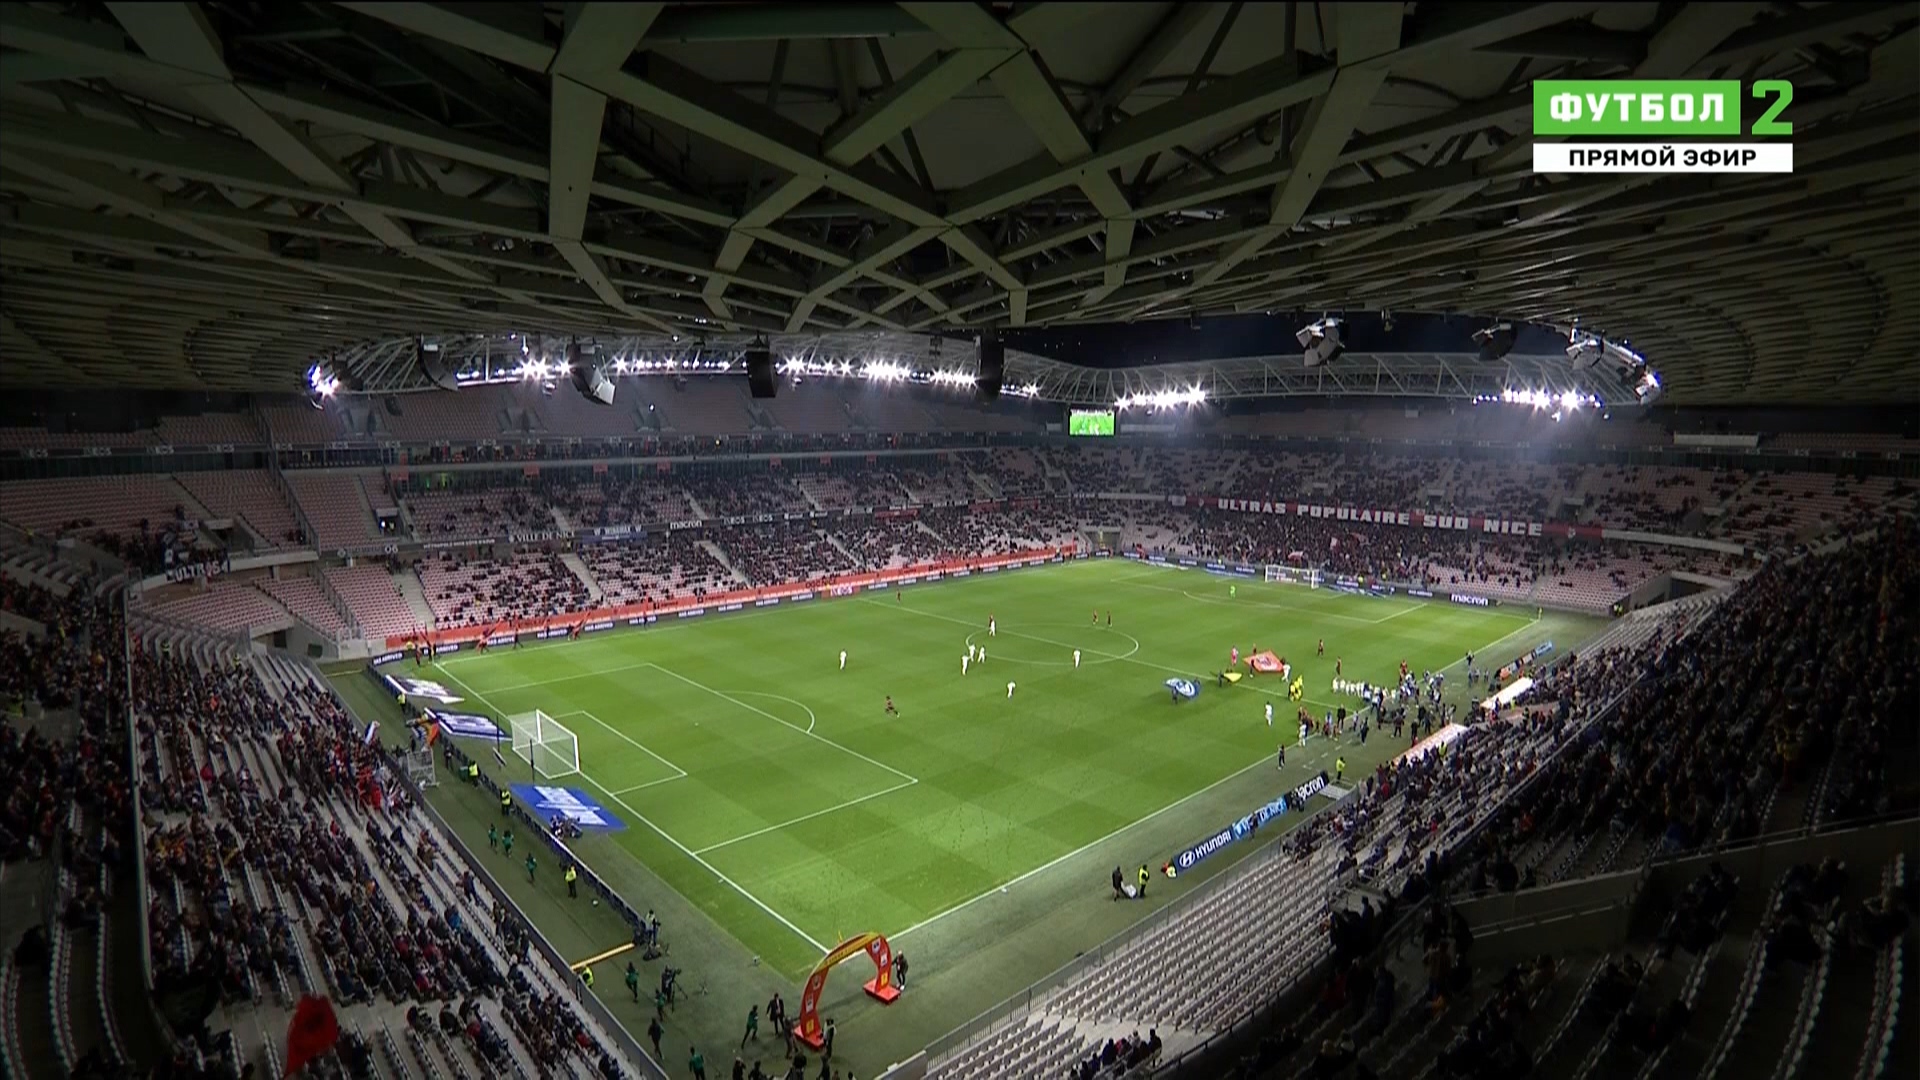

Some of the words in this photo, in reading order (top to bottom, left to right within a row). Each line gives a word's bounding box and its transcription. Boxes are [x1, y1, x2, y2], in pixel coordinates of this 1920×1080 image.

[669, 520, 703, 530] macron
[1217, 498, 1286, 514] ULTRAS
[1297, 504, 1410, 526] POPULAIRE
[1423, 515, 1469, 530] SUD
[1483, 519, 1543, 536] NICE
[1451, 593, 1489, 606] macron
[1194, 829, 1232, 859] HYUNDAI
